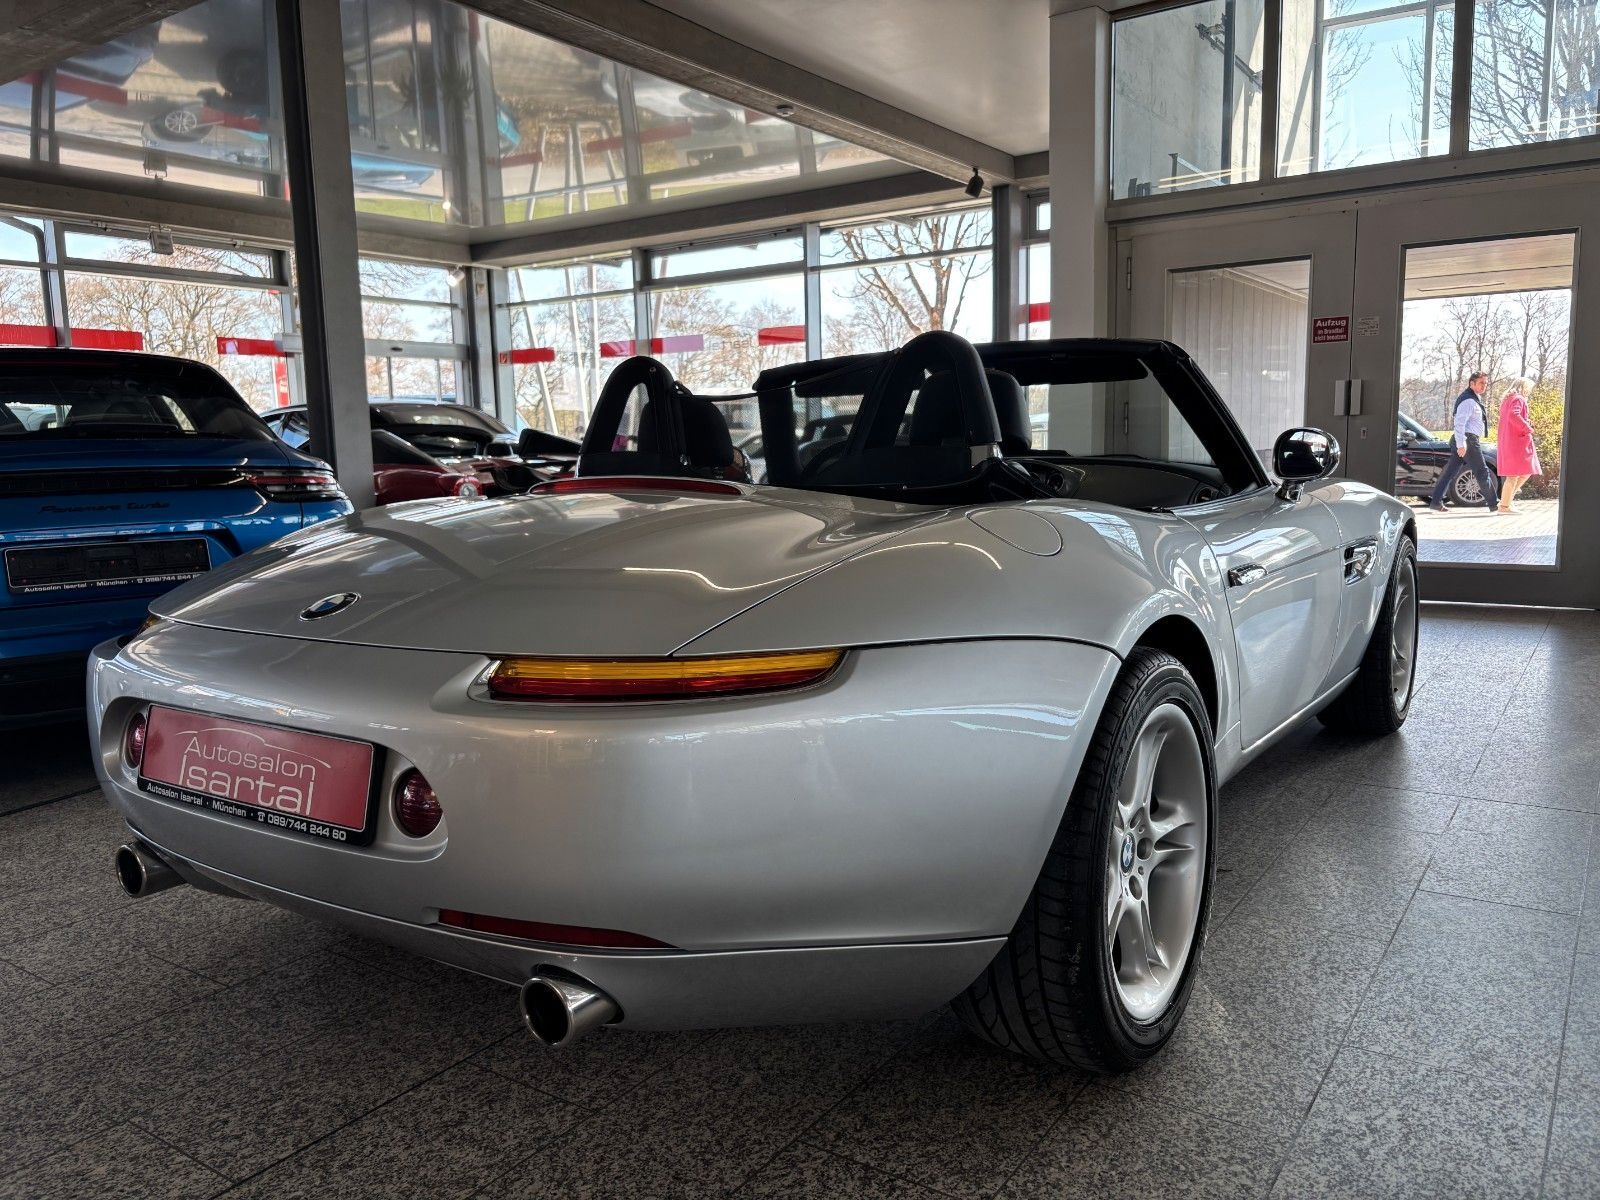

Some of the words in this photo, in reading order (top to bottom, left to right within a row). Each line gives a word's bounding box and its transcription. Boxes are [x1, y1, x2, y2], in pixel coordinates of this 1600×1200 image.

[1316, 319, 1346, 327] Aufzug
[24, 584, 62, 593] Autosalon
[63, 582, 87, 590] Isartal
[96, 579, 128, 588] München
[184, 736, 316, 781] Autosalon
[178, 754, 314, 816] Isartal
[146, 782, 179, 799] Autosalon
[180, 791, 203, 806] Isartal
[212, 801, 247, 817] München
[267, 813, 307, 832] 089/744
[309, 824, 330, 838] 244
[332, 829, 347, 841] 60
